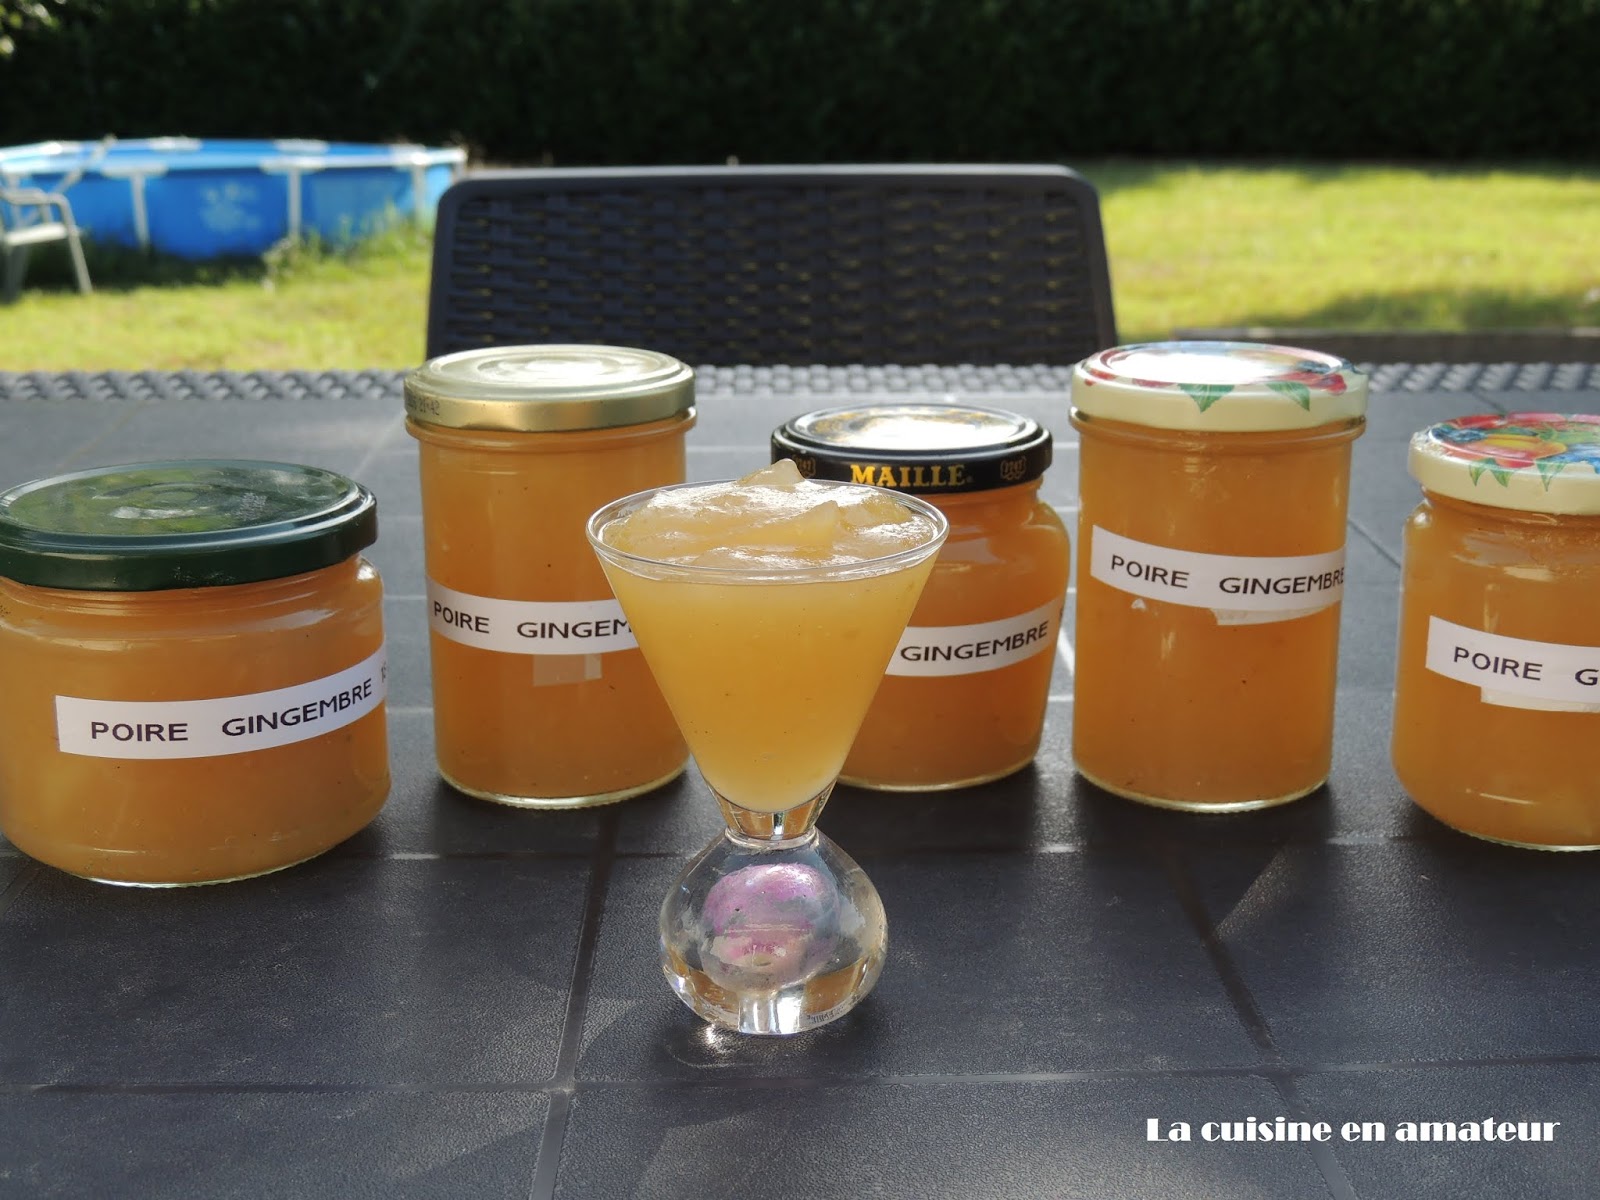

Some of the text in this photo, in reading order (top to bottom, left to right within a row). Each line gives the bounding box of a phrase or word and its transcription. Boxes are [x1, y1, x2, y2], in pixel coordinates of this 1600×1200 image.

[850, 464, 966, 488] MAILLE
[1110, 554, 1190, 588] POIRE
[434, 601, 490, 634] POIRE
[900, 620, 1049, 661] GINGEMBRE
[1453, 646, 1543, 681] POIRE
[91, 678, 373, 742] POIRE GINGEMBRE
